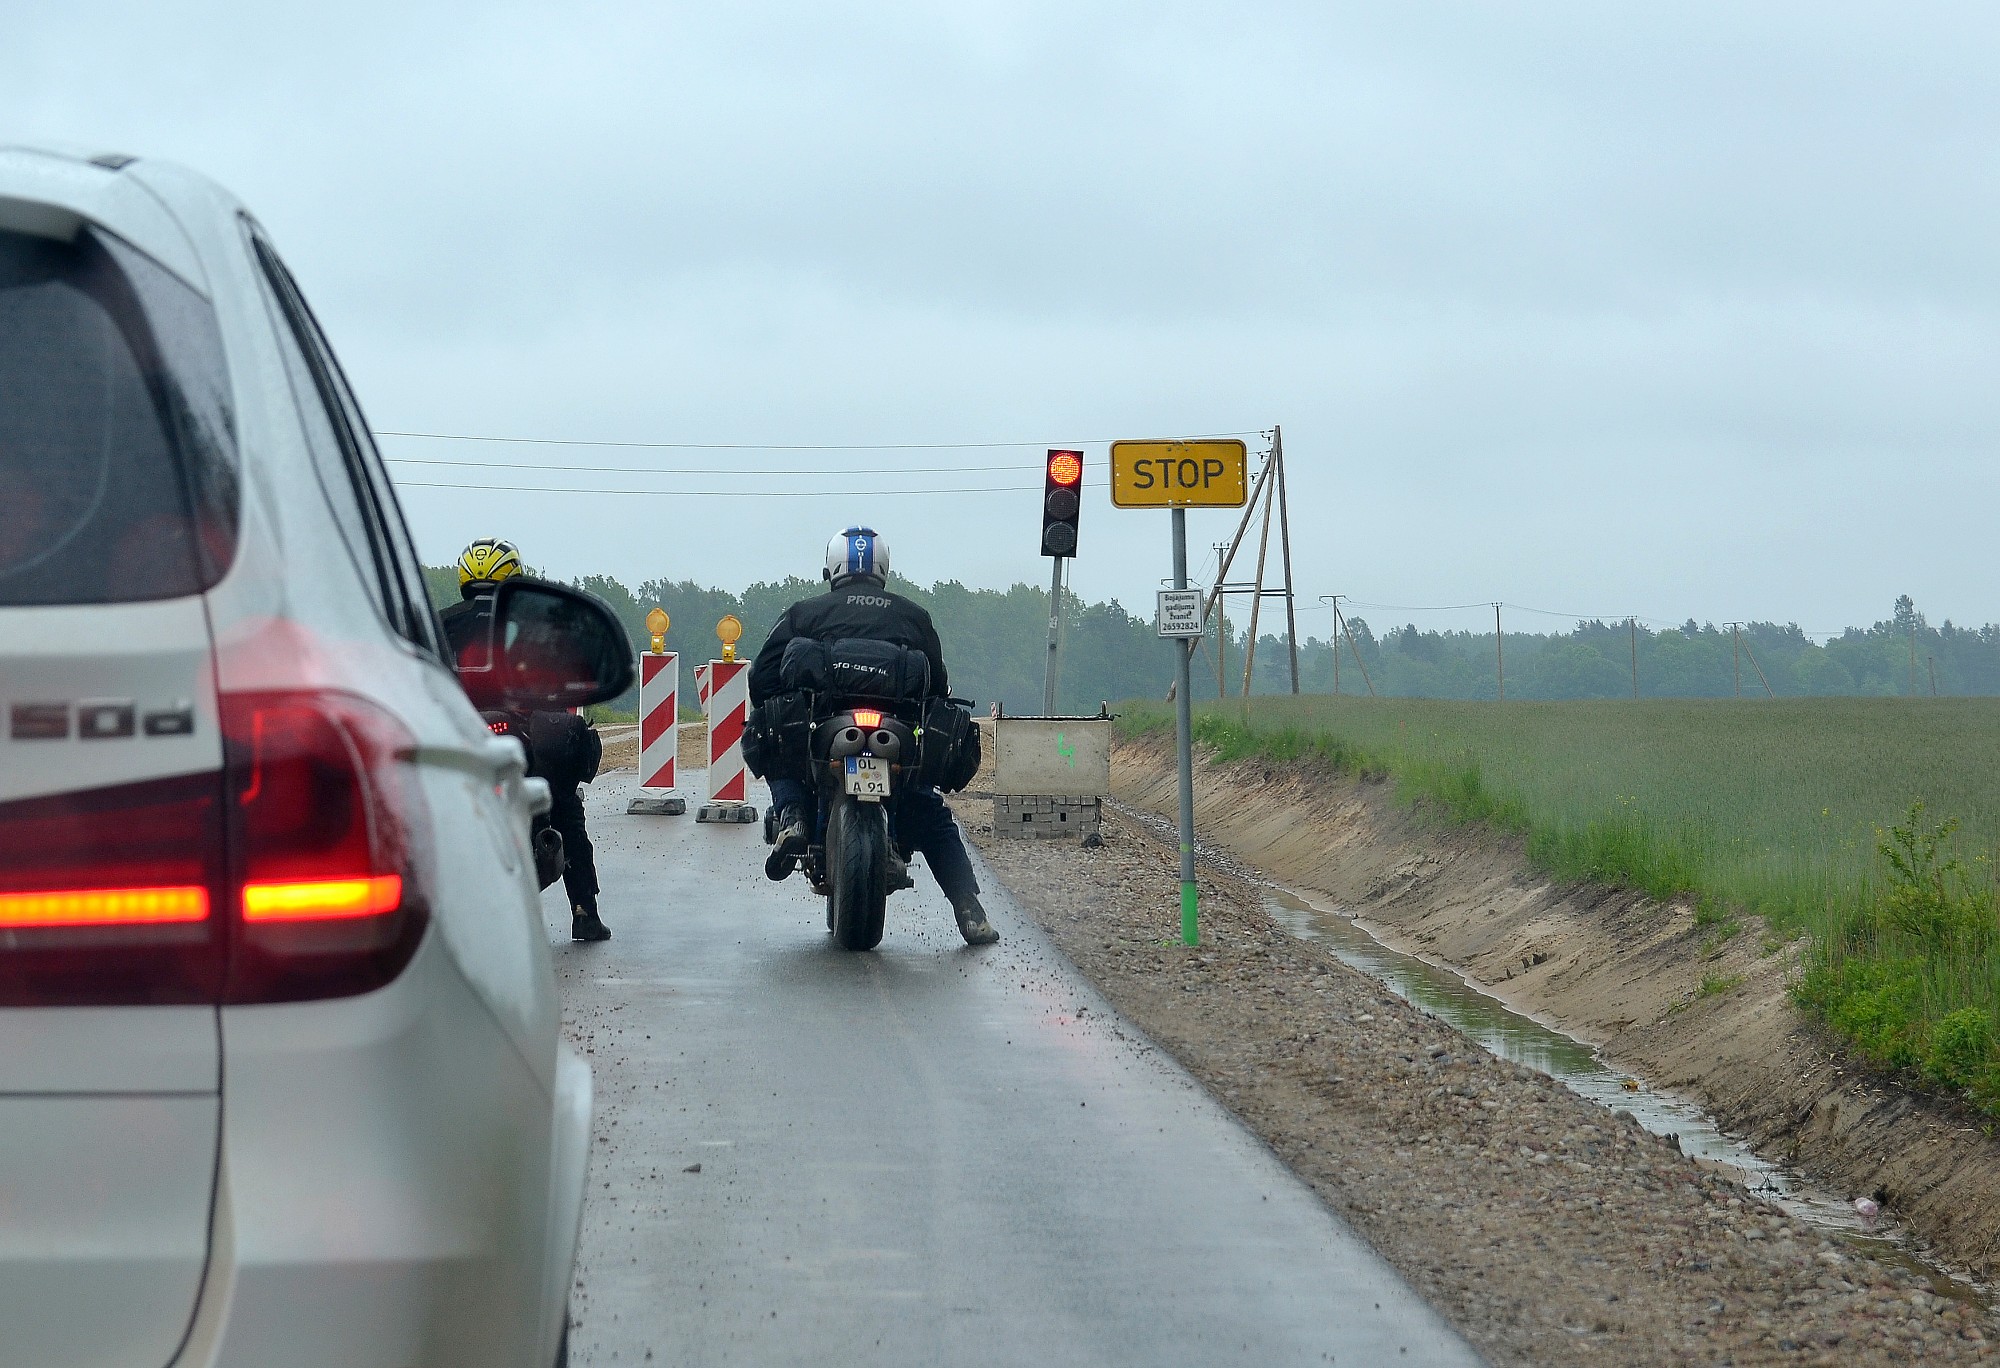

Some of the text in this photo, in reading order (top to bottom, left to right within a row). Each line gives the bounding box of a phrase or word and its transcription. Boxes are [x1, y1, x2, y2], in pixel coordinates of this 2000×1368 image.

[1133, 458, 1225, 489] STOP
[846, 595, 892, 608] PROOF
[1162, 622, 1198, 630] 26592824
[859, 759, 876, 769] OL
[853, 782, 885, 793] A 91
